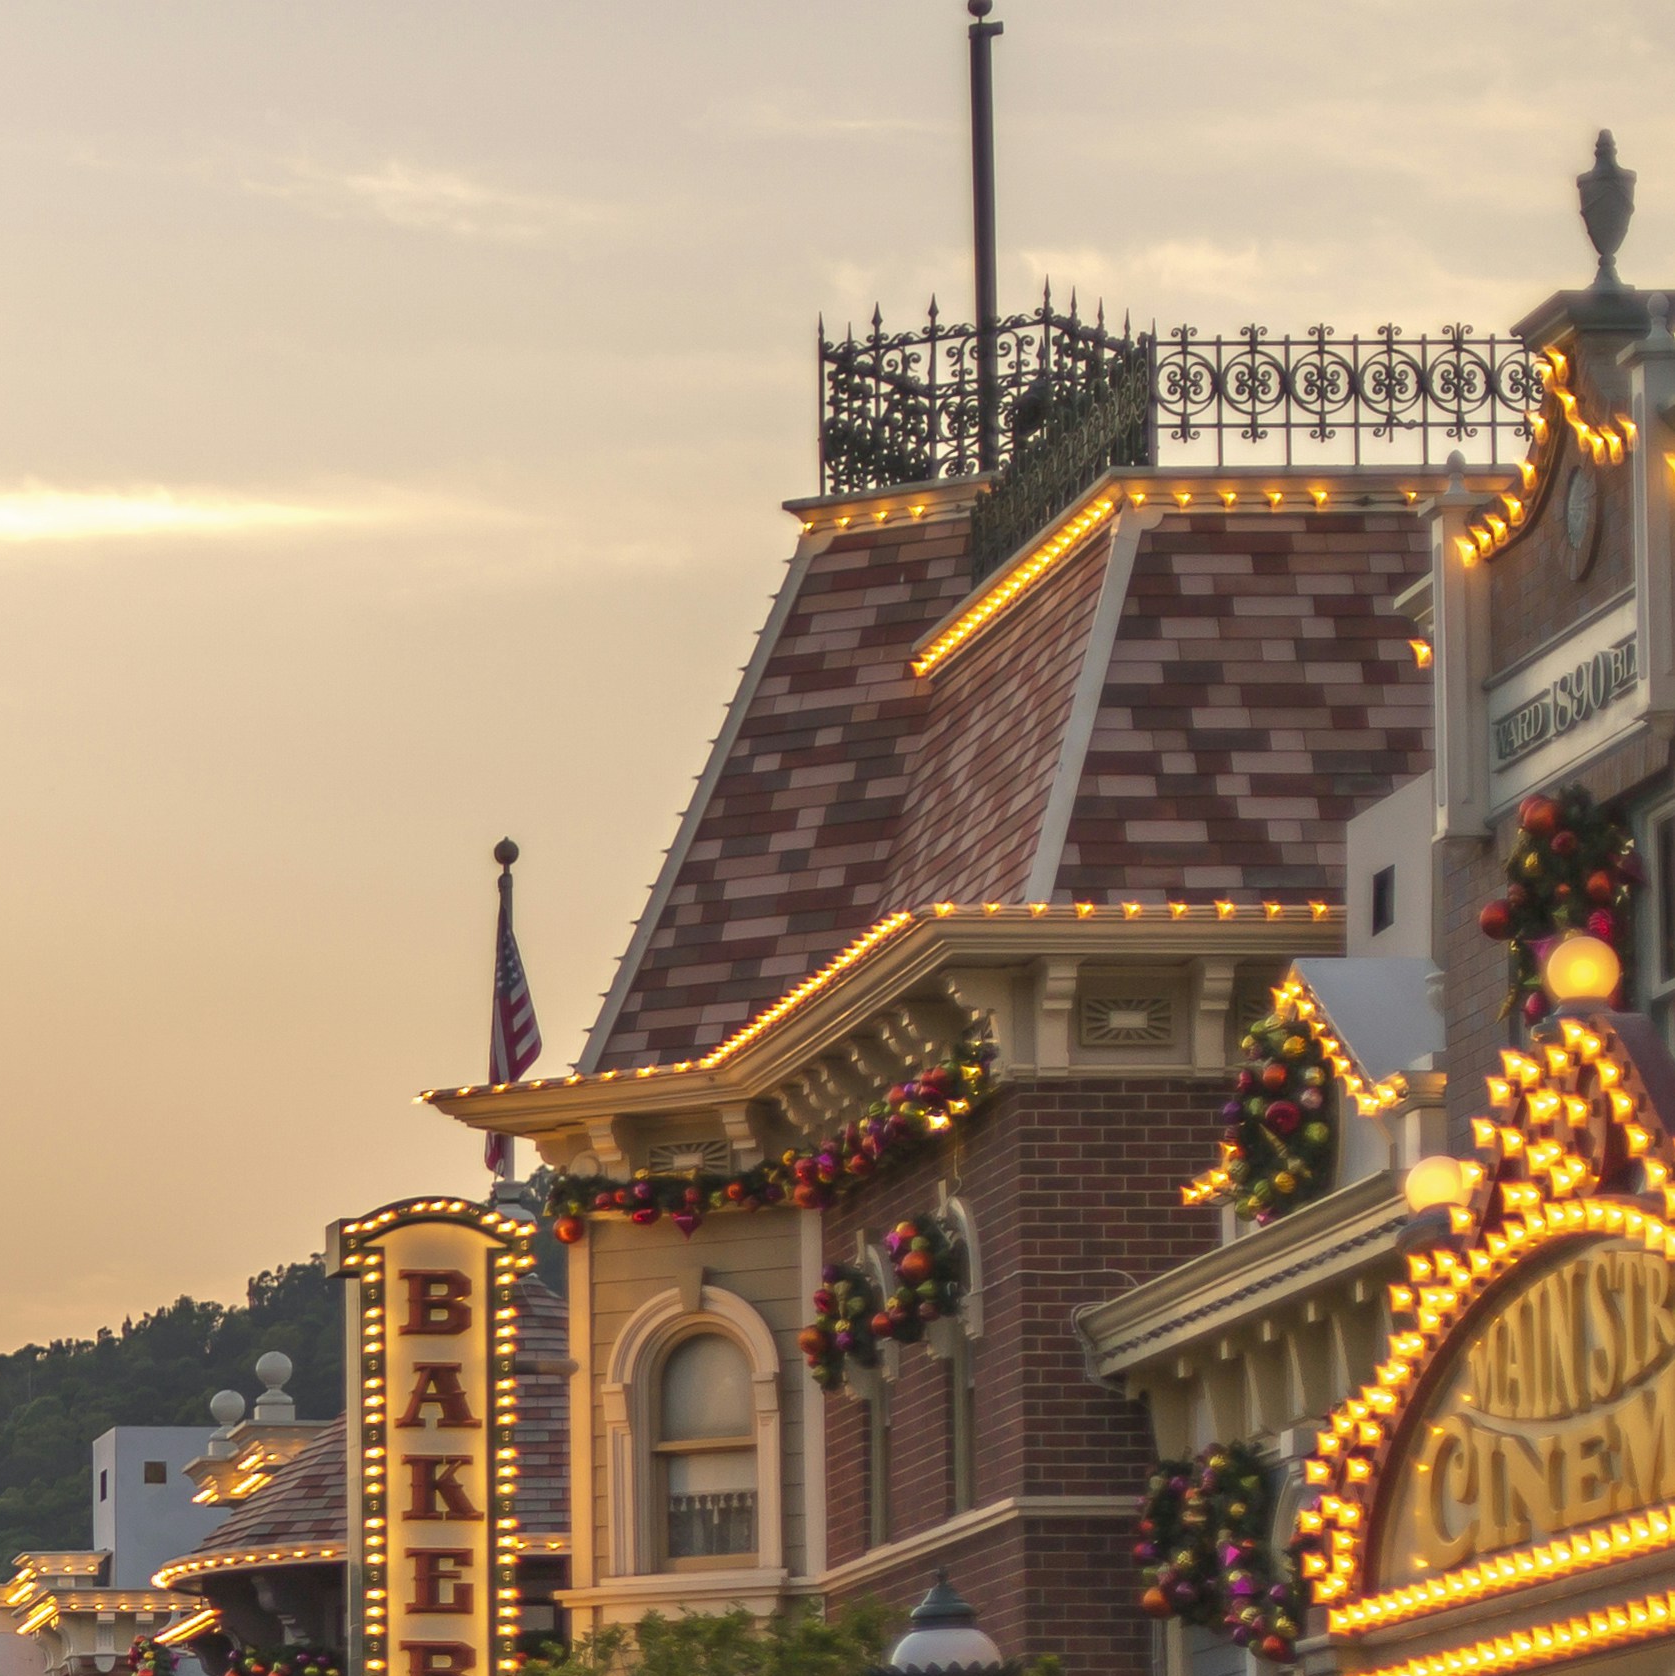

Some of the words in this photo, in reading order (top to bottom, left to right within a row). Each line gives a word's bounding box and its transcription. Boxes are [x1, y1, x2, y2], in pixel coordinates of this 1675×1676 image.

[1550, 652, 1604, 733] 1890
[1610, 643, 1637, 687] BL
[1468, 1260, 1582, 1418] MAIN
